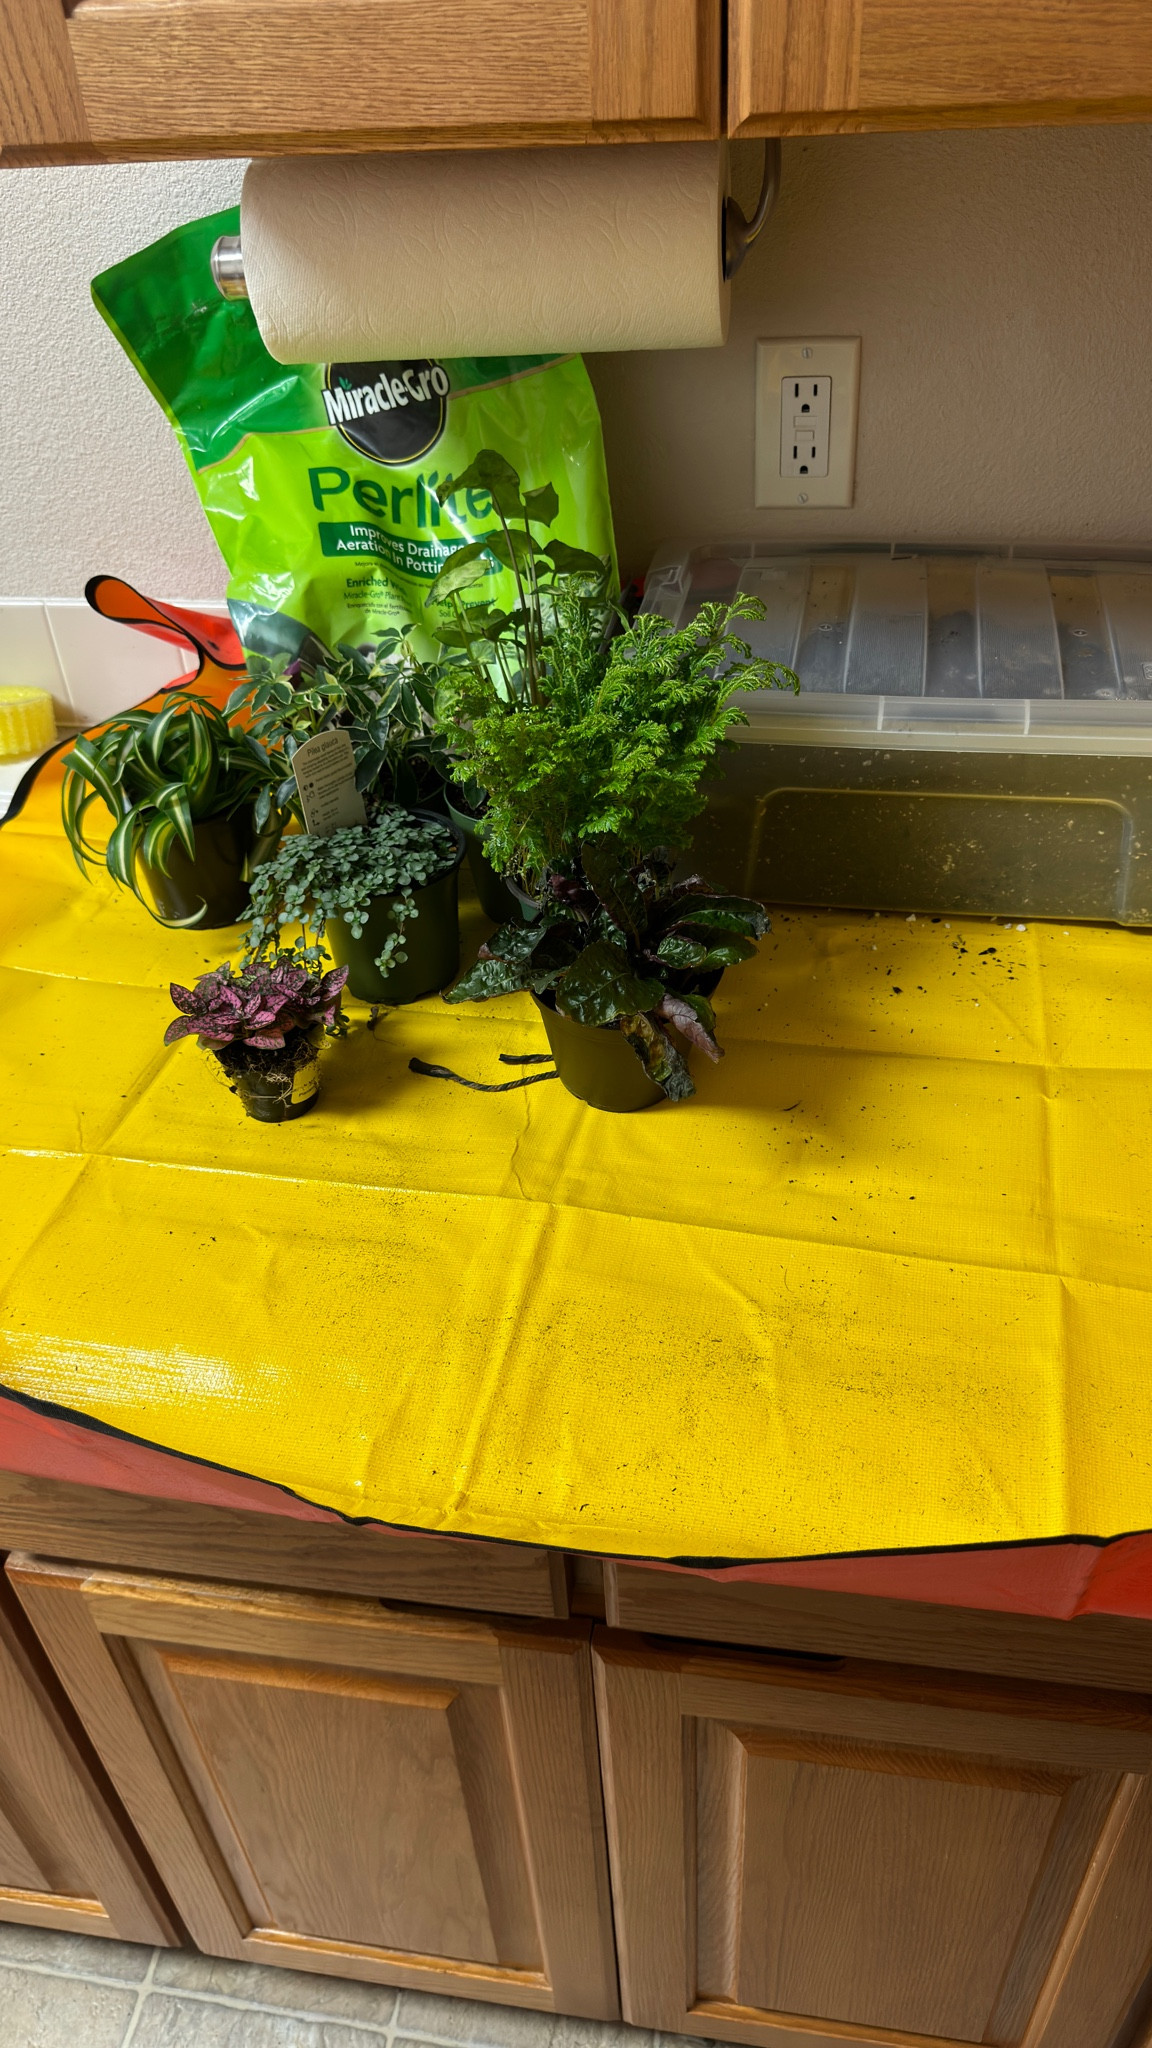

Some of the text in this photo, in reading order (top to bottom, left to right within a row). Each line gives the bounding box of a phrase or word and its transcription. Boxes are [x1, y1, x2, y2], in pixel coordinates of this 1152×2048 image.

[322, 366, 449, 425] Miracle-Gro
[308, 466, 493, 529] Perlite
[336, 539, 392, 559] Aeration
[392, 551, 404, 566] In
[349, 524, 405, 553] Improves
[346, 576, 389, 588] Enriched
